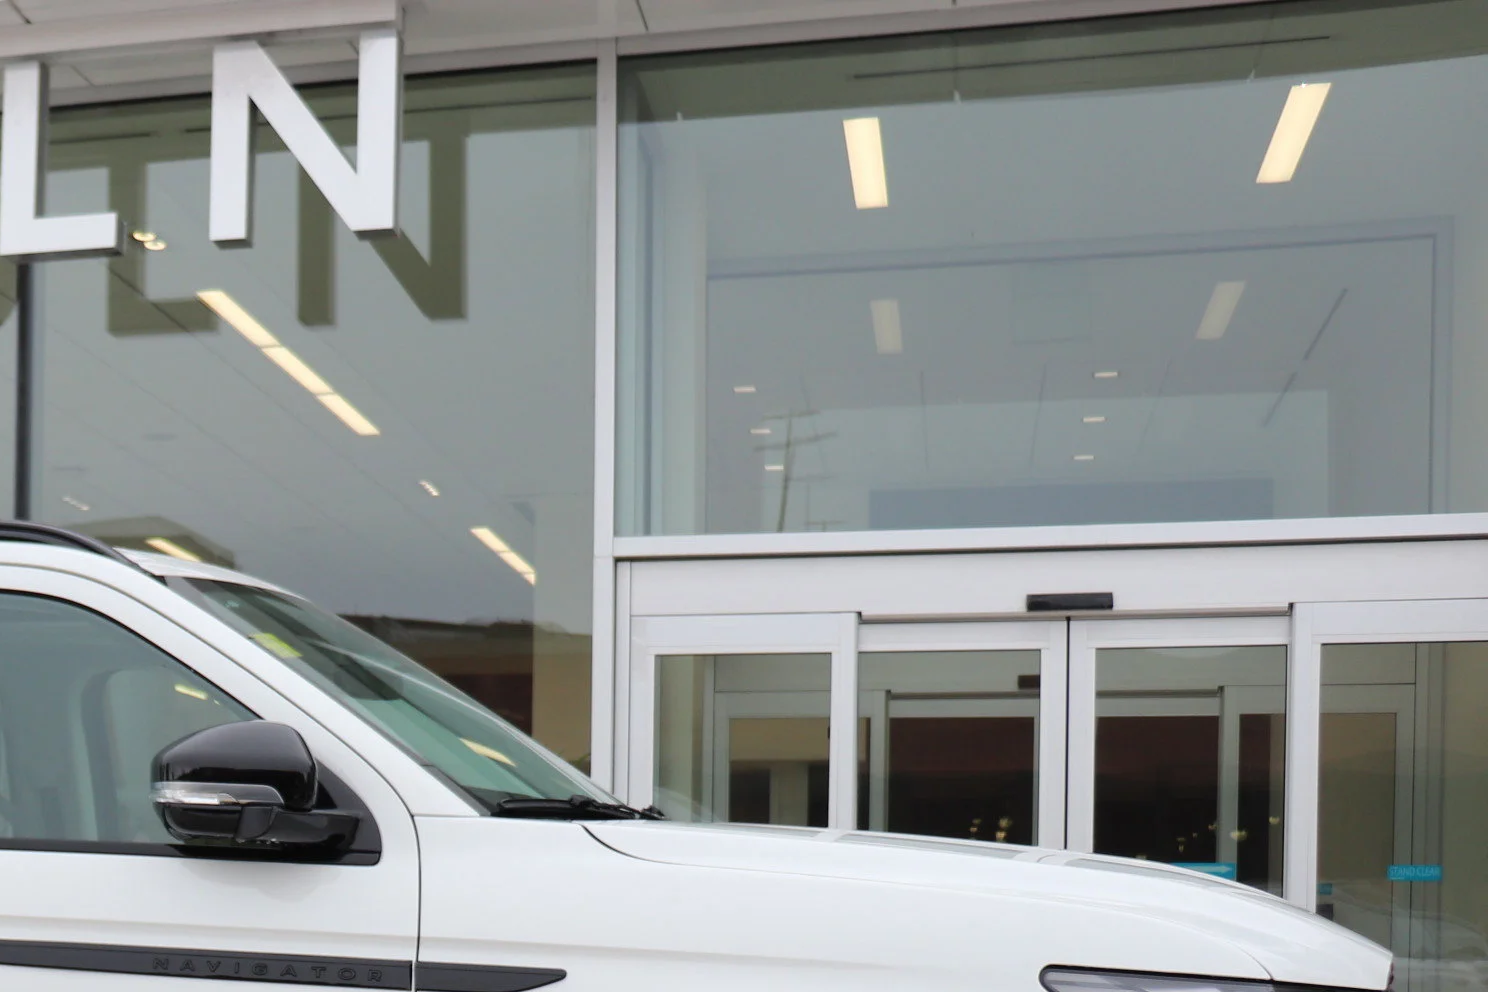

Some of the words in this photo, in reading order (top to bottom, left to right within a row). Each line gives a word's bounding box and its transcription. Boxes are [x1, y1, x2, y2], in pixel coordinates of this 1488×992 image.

[1388, 866, 1415, 877] STAND
[1416, 866, 1440, 877] CLEAR
[152, 957, 383, 982] NAVIGATOR
